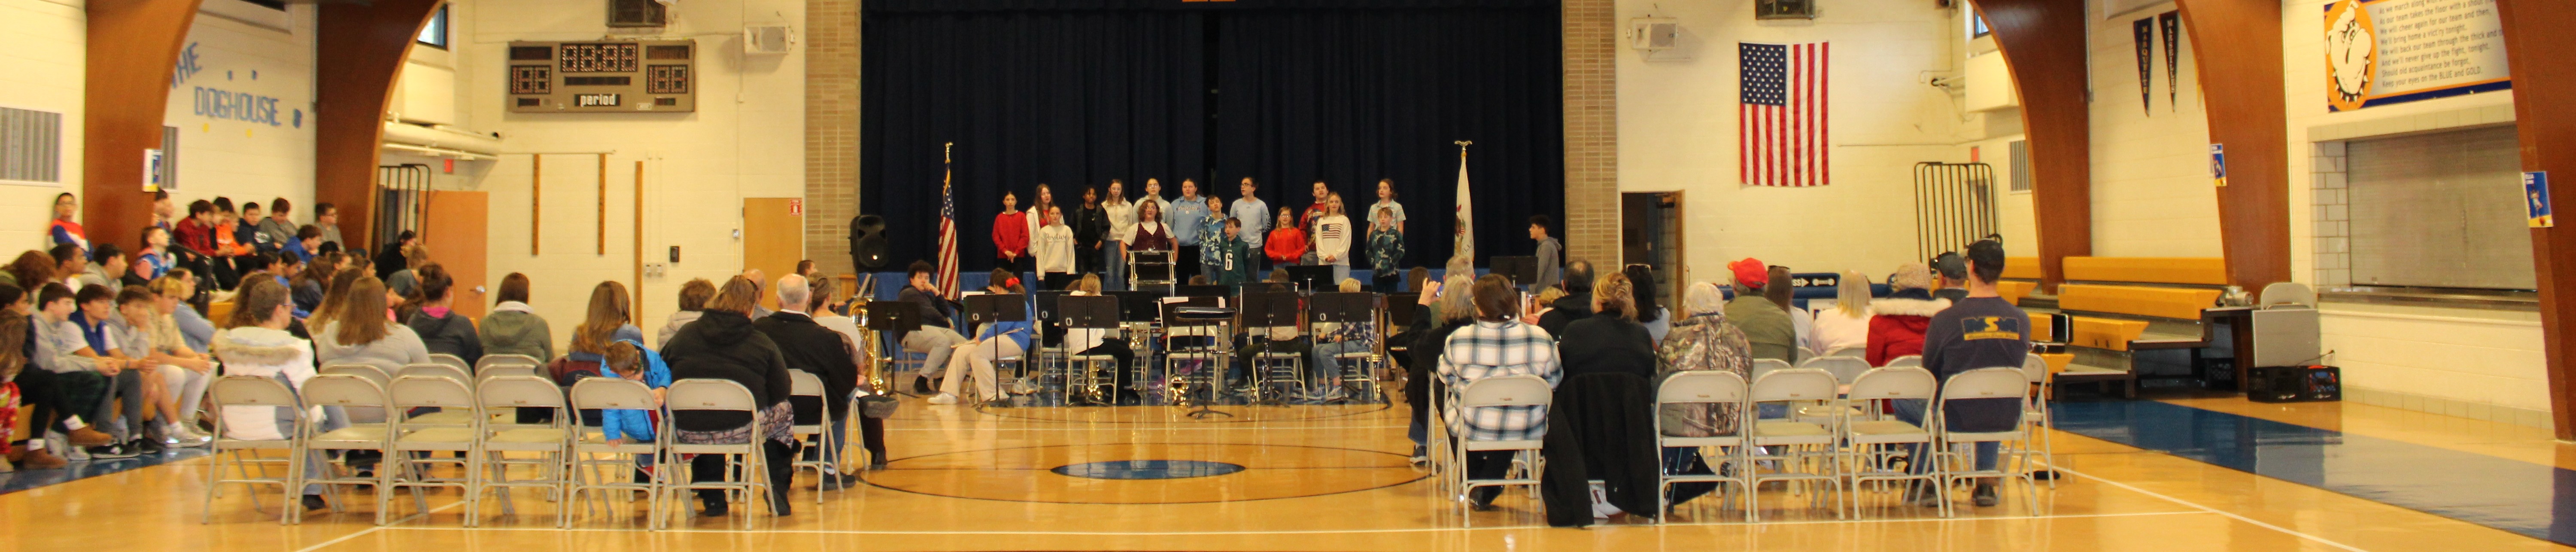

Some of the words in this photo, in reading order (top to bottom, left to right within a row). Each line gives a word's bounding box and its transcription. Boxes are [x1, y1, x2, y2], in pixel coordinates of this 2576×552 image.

[2395, 1, 2410, 11] march
[2409, 11, 2424, 19] takes
[2399, 24, 2413, 32] cheer
[2414, 21, 2428, 30] again
[2448, 14, 2462, 22] team
[2394, 35, 2407, 44] bring
[2408, 33, 2421, 41] home
[2400, 44, 2412, 53] back
[2437, 38, 2458, 46] through
[2470, 31, 2485, 41] thick
[2487, 30, 2497, 38] and
[2406, 55, 2419, 63] never
[2421, 53, 2431, 63] give
[2433, 52, 2440, 60] up
[2382, 68, 2399, 78] Should
[2400, 67, 2408, 75] old
[2409, 63, 2442, 73] acquaintance
[2395, 79, 2407, 88] your
[2408, 77, 2420, 85] eyes
[2439, 70, 2453, 79] BLUE
[2454, 69, 2465, 77] and
[195, 86, 282, 126] DOGHOUSE
[580, 94, 615, 107] period
[1225, 253, 1233, 271] 6
